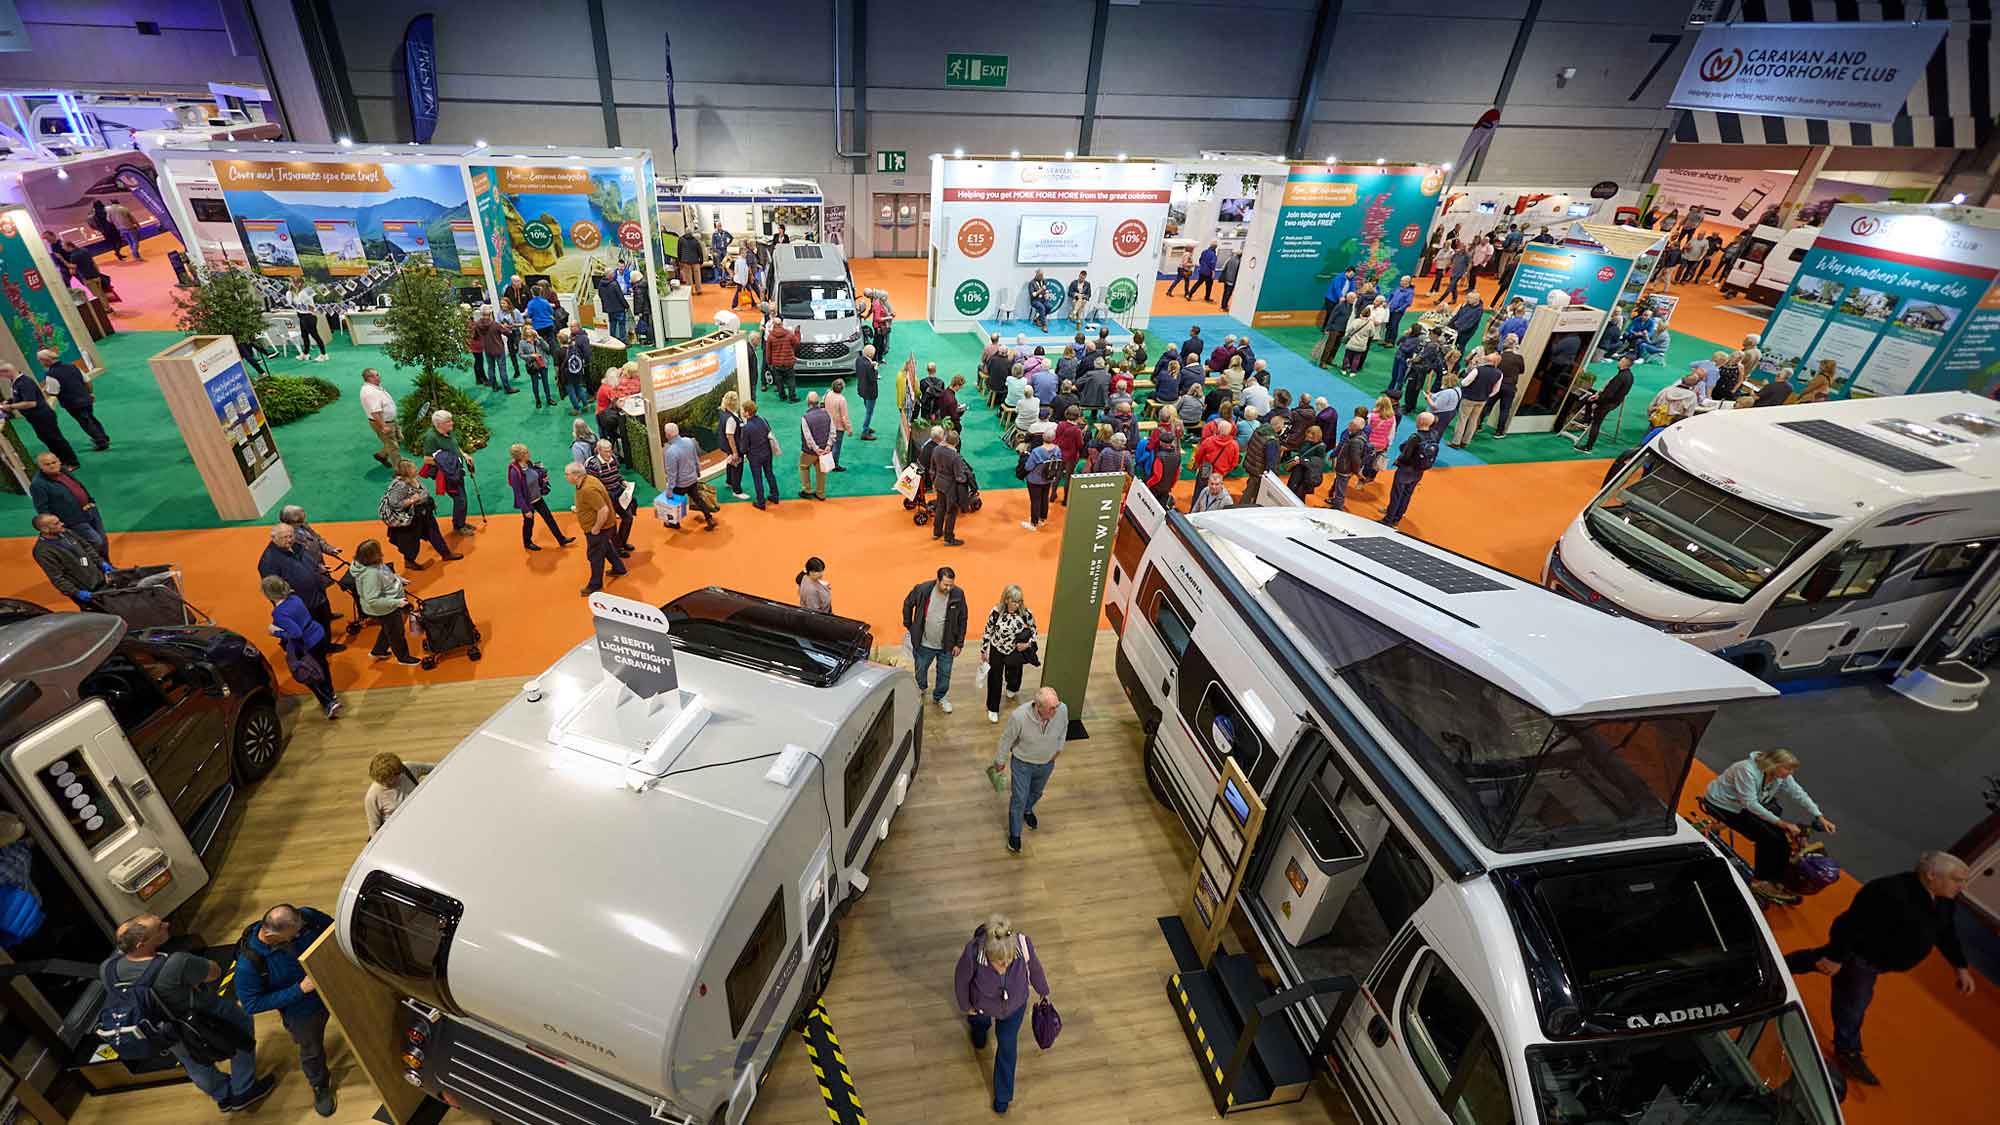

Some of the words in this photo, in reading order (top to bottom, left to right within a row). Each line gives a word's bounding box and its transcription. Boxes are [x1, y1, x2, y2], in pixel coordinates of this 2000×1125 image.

[1747, 49, 1823, 64] CARAVAN
[1824, 51, 1867, 66] AND
[982, 64, 1006, 76] EXIT
[1628, 34, 1681, 101] 7
[1739, 64, 1849, 81] MOTORHOME
[1851, 68, 1898, 82] CLUB
[1734, 92, 1752, 100] MORE
[1755, 94, 1774, 102] MORE
[228, 166, 256, 182] Cover
[256, 168, 275, 182] and
[276, 167, 320, 182] Insurance
[322, 172, 340, 184] you
[357, 170, 380, 182] trust
[1670, 169, 1698, 177] Discover
[1699, 171, 1722, 180] what's
[1724, 175, 1744, 184] here!
[958, 191, 985, 199] Helping
[986, 192, 1000, 200] you
[1000, 192, 1012, 200] get
[1110, 192, 1128, 200] great
[1128, 192, 1158, 200] outdoors
[1297, 220, 1316, 228] nights
[1300, 212, 1317, 220] today
[1331, 212, 1342, 220] get
[529, 231, 547, 240] 10%
[626, 232, 640, 240] £20
[967, 234, 984, 242] £15
[1120, 234, 1140, 243] 10%
[1816, 255, 1844, 275] Why
[1844, 265, 1898, 284] members
[1898, 272, 1920, 288] love
[1921, 280, 1940, 292] our
[962, 293, 982, 302] 10%
[1698, 474, 1722, 485] ROLLER
[1092, 499, 1113, 552] TWIN
[1090, 560, 1102, 604] GENERATION
[1185, 572, 1202, 596] ADRIA
[611, 606, 664, 625] ADRIA
[613, 634, 620, 642] 2
[620, 636, 655, 652] BERTH
[600, 641, 672, 667] LIGHTWEIGHT
[614, 654, 661, 674] CARAVAN
[1653, 1002, 1730, 1026] ADRIA
[560, 1031, 616, 1058] ADRIA
